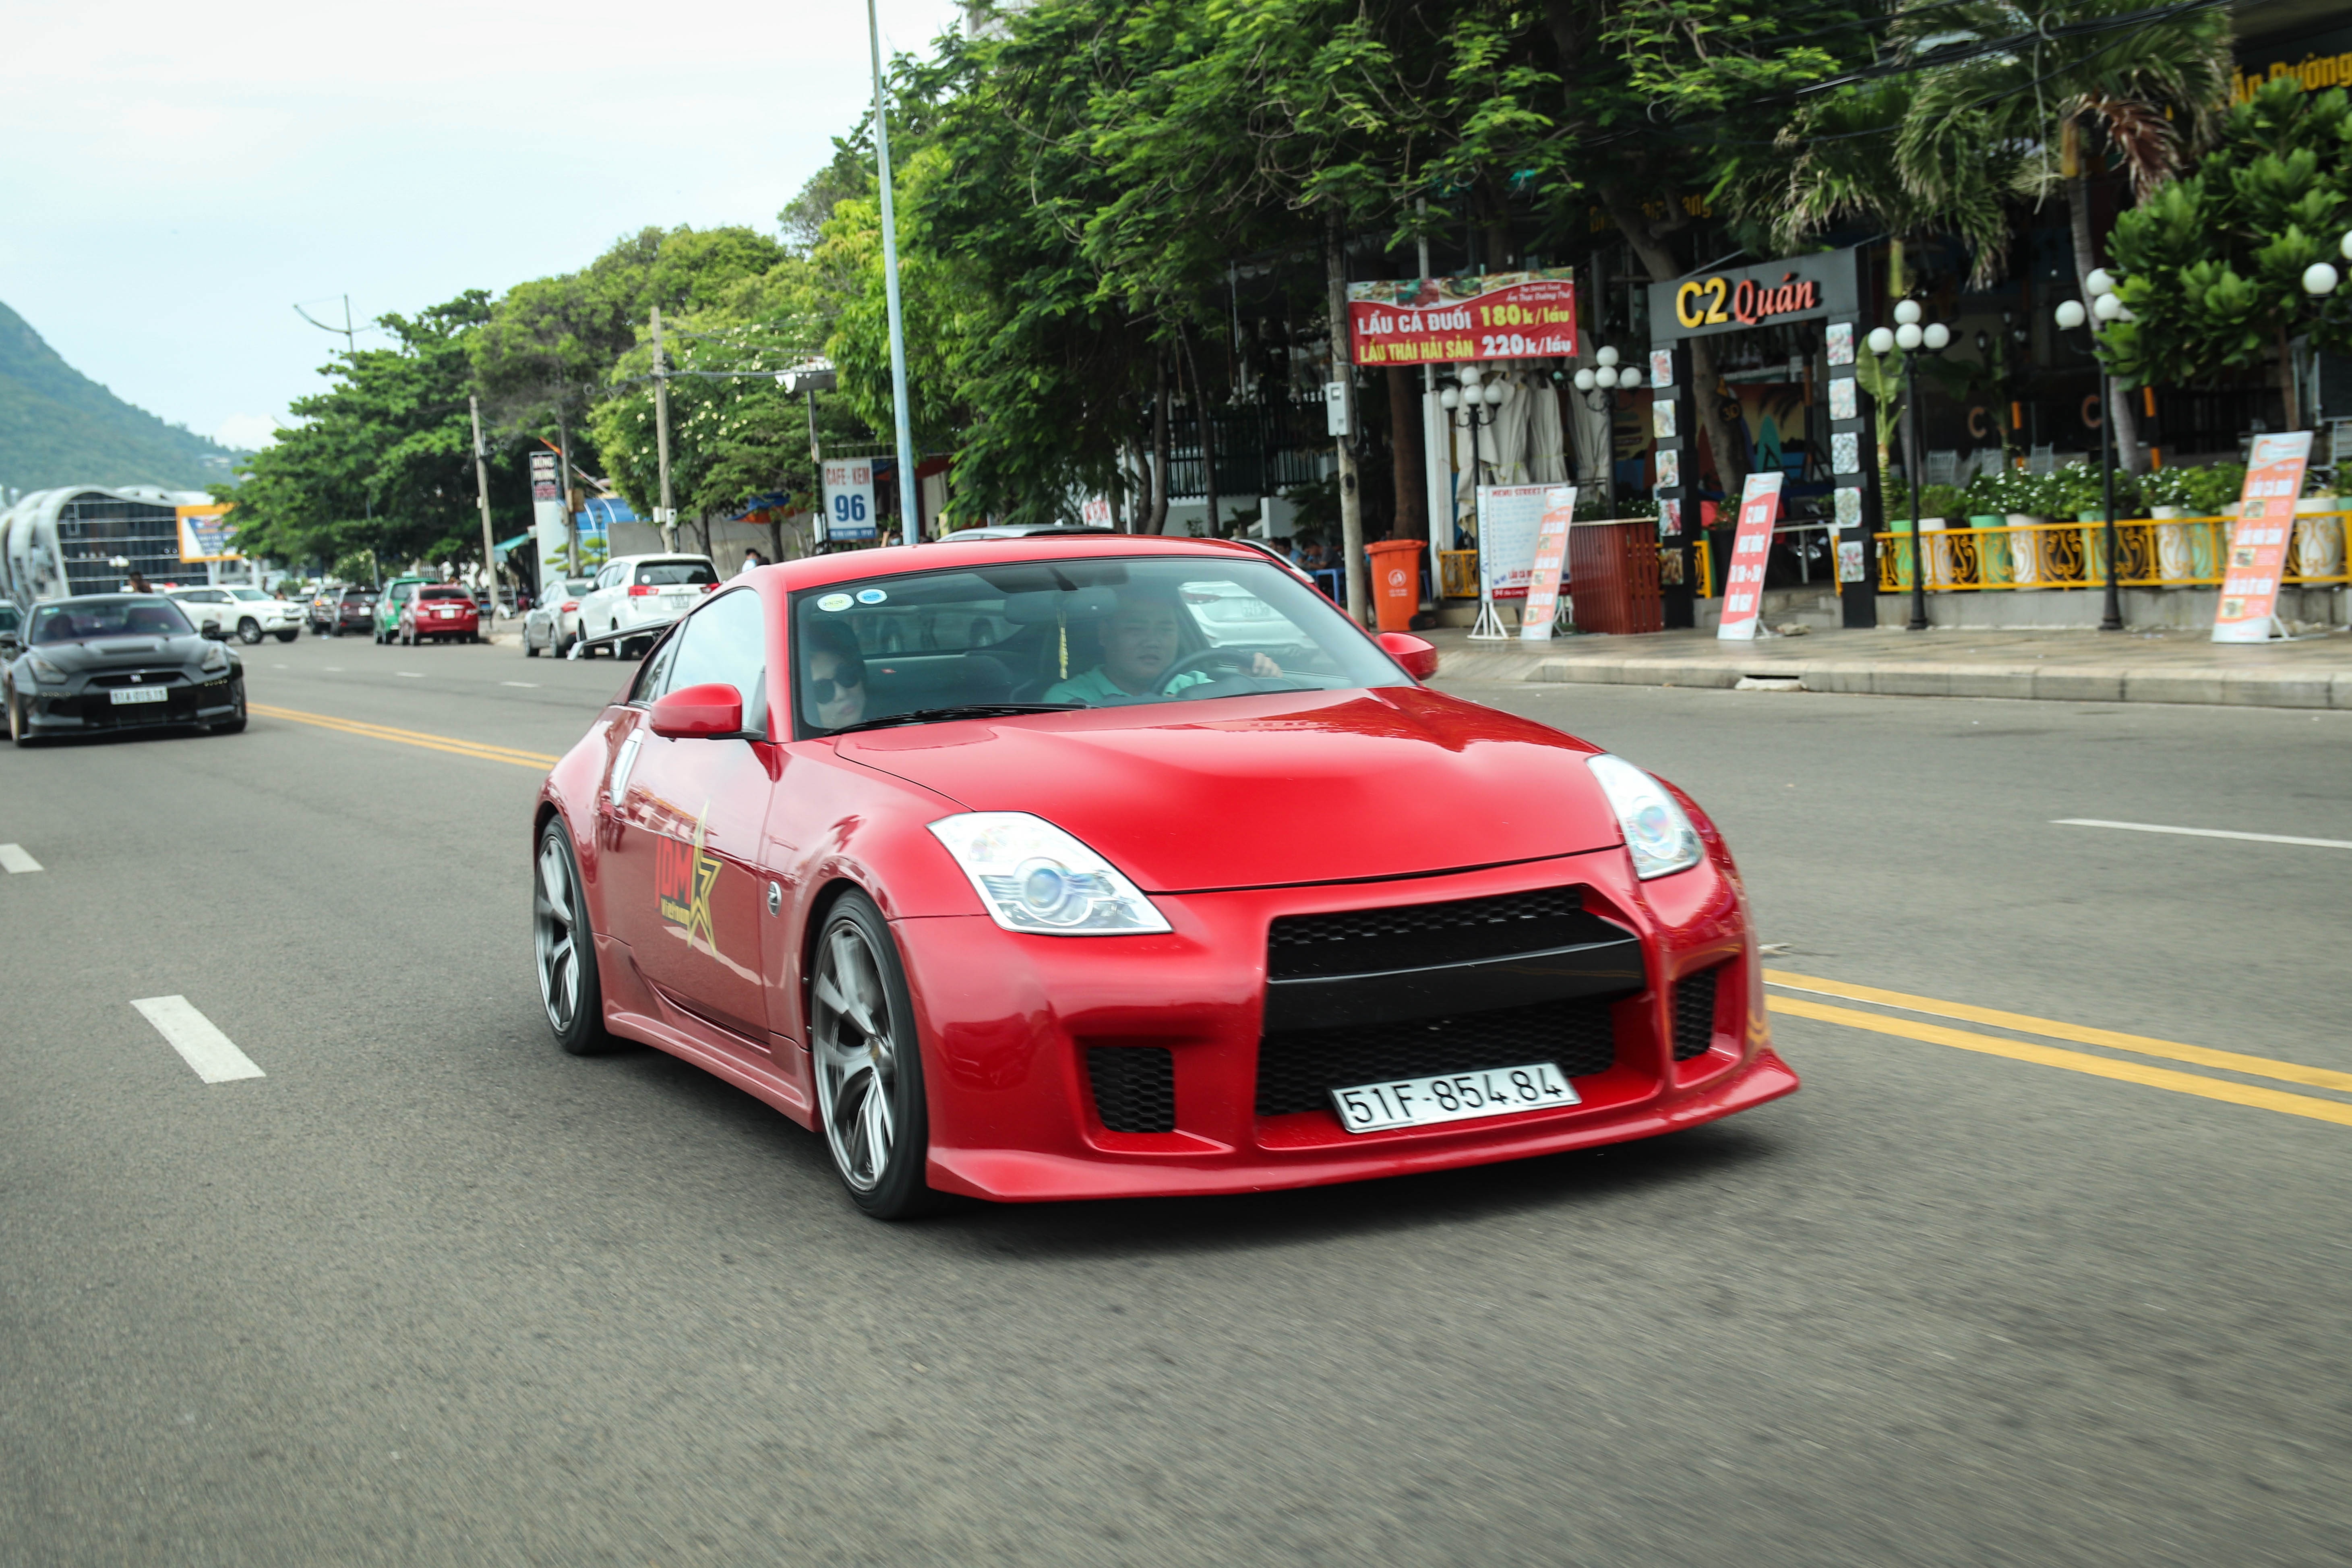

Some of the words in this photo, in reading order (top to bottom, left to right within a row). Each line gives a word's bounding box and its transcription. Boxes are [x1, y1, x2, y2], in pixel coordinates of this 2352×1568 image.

[1676, 276, 1728, 329] C2
[1733, 272, 1816, 325] Quán
[1398, 310, 1424, 333] CÁ
[1427, 305, 1472, 331] ĐUỐI
[1388, 338, 1418, 361] THÁI
[1420, 335, 1443, 360] HẢI
[1446, 333, 1474, 358] SẢN
[826, 468, 848, 486] CAFE
[835, 494, 865, 521] 96
[1342, 1067, 1563, 1123] 51F-854.84
